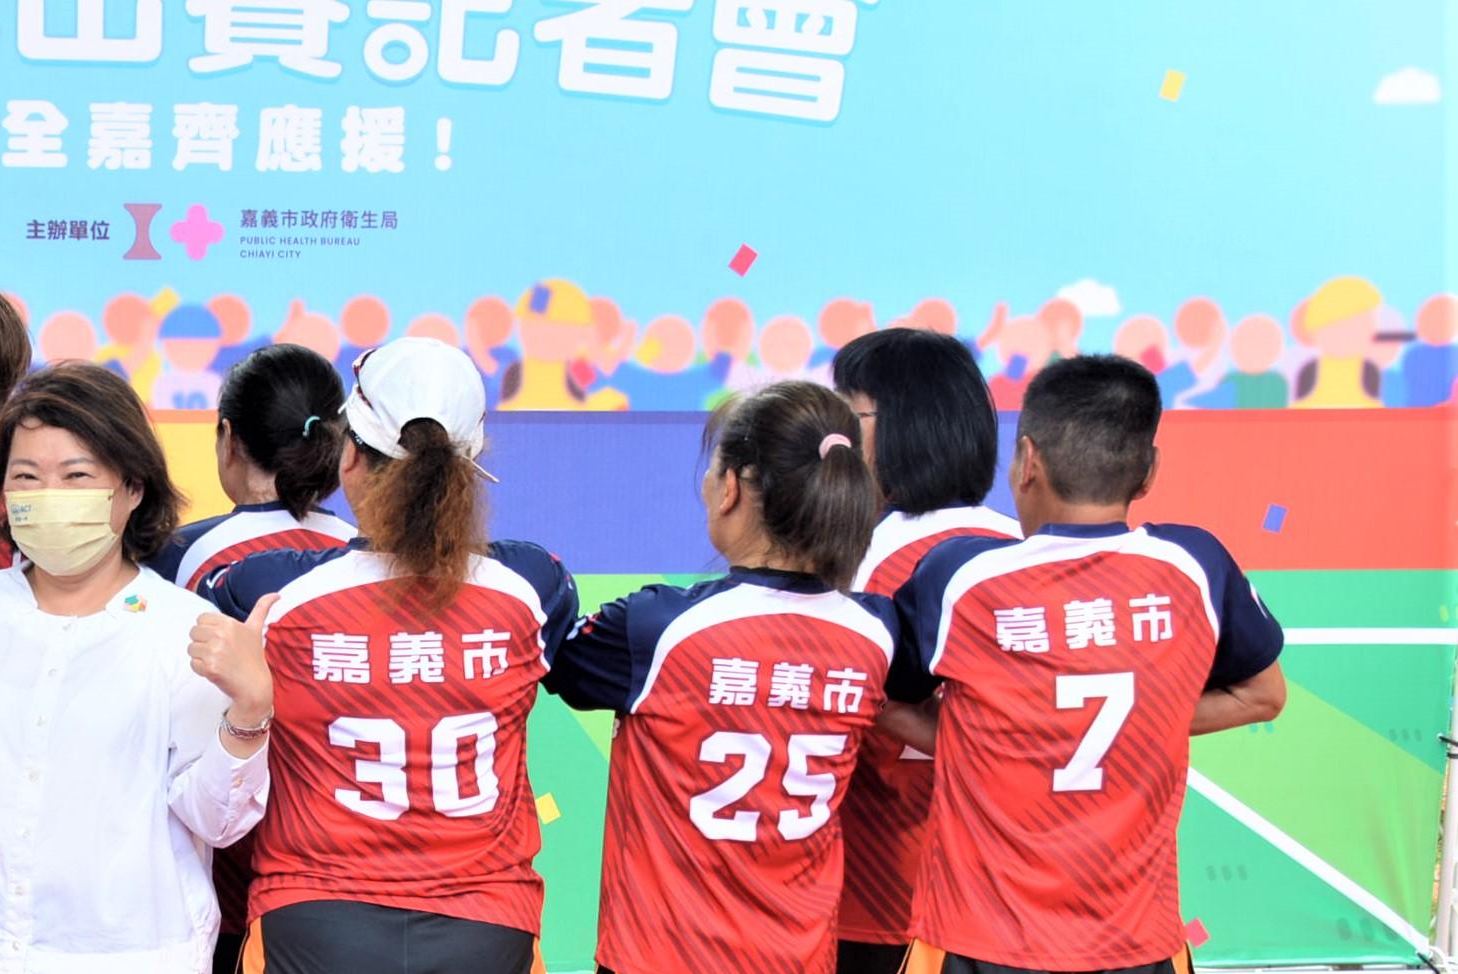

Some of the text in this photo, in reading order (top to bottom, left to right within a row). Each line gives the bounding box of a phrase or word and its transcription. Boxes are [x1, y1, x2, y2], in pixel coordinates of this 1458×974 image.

[26, 219, 110, 241] 主辦單位
[239, 235, 361, 247] PUBLIC HEALTH BUREAU
[240, 208, 399, 230] 嘉義市政府衛生局
[239, 249, 302, 260] CHIAYI CITY
[994, 592, 1174, 653] 嘉義市
[310, 628, 512, 685] 嘉義市
[709, 656, 868, 715] 嘉義市
[1053, 671, 1135, 793] 7
[327, 711, 501, 821] 30
[689, 731, 848, 842] 25
